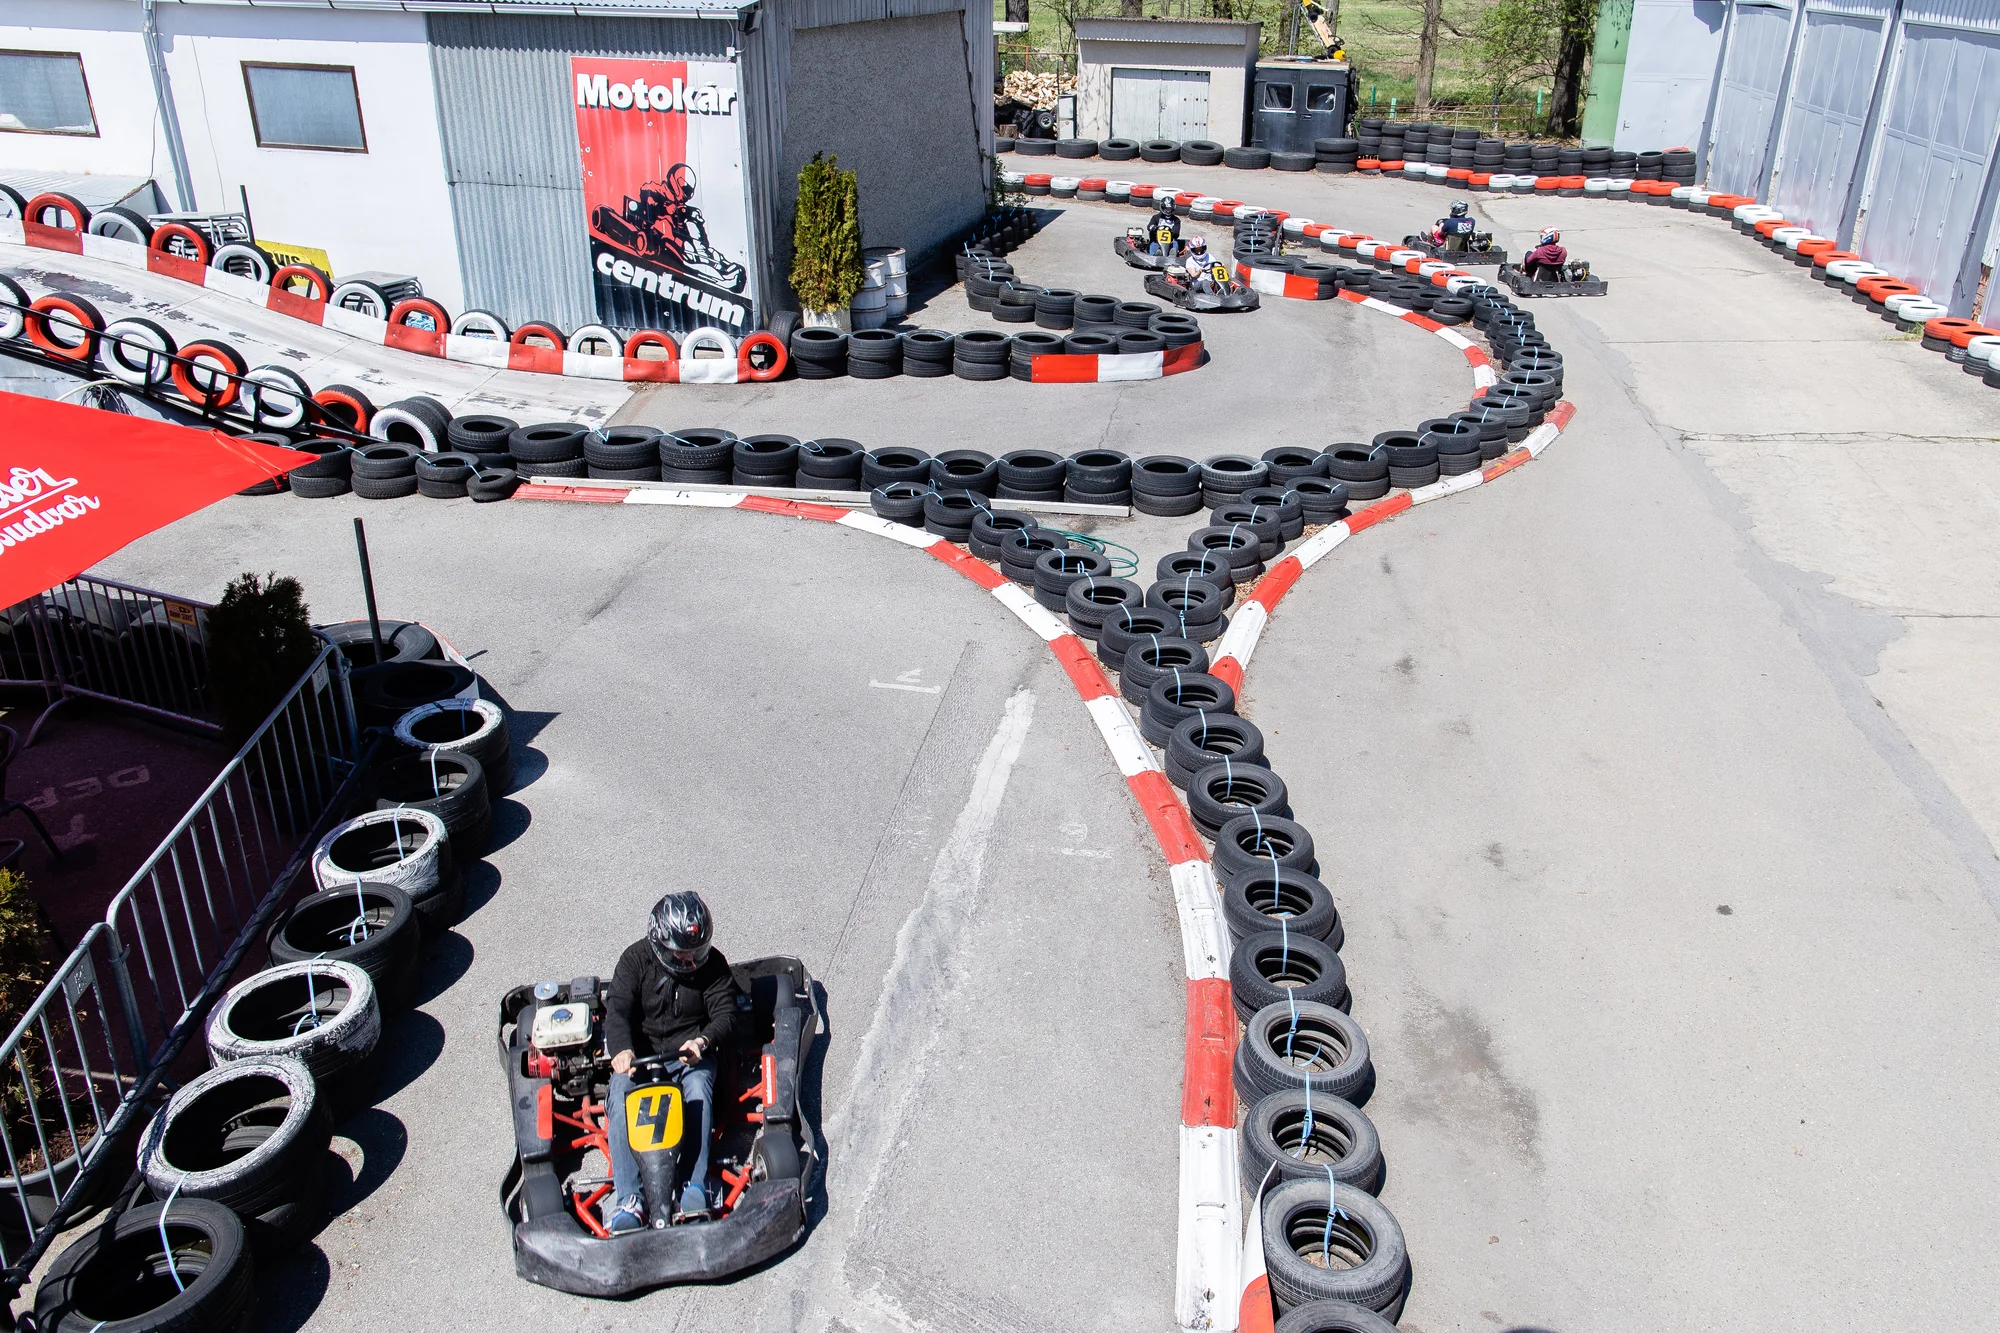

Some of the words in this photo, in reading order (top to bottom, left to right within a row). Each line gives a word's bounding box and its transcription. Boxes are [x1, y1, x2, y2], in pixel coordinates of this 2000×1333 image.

[1160, 232, 1169, 241] 5
[597, 252, 746, 327] centrum
[1217, 269, 1225, 280] 8
[0, 494, 100, 555] udvar
[636, 1092, 673, 1145] 4
